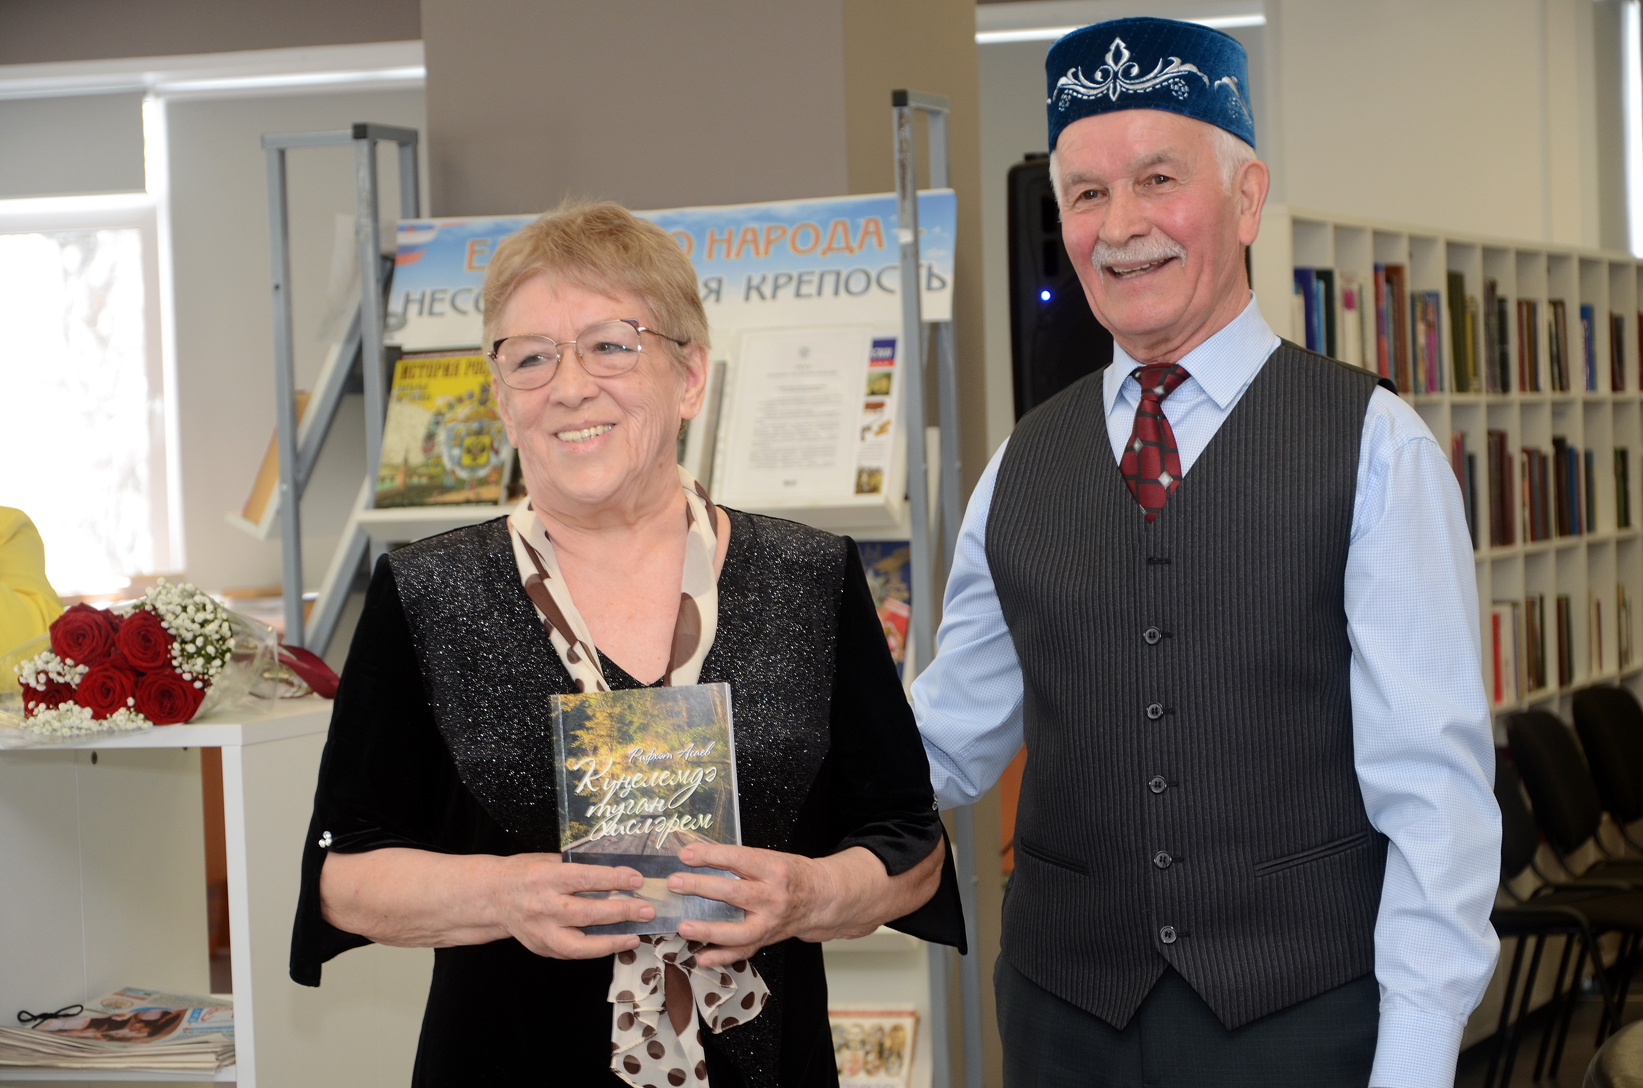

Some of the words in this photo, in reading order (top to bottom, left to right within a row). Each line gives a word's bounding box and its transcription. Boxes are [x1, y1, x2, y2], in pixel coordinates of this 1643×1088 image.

[705, 217, 885, 260] НАРОДА
[743, 262, 947, 302] КРЕПОСЬ
[677, 741, 716, 761] Асаев
